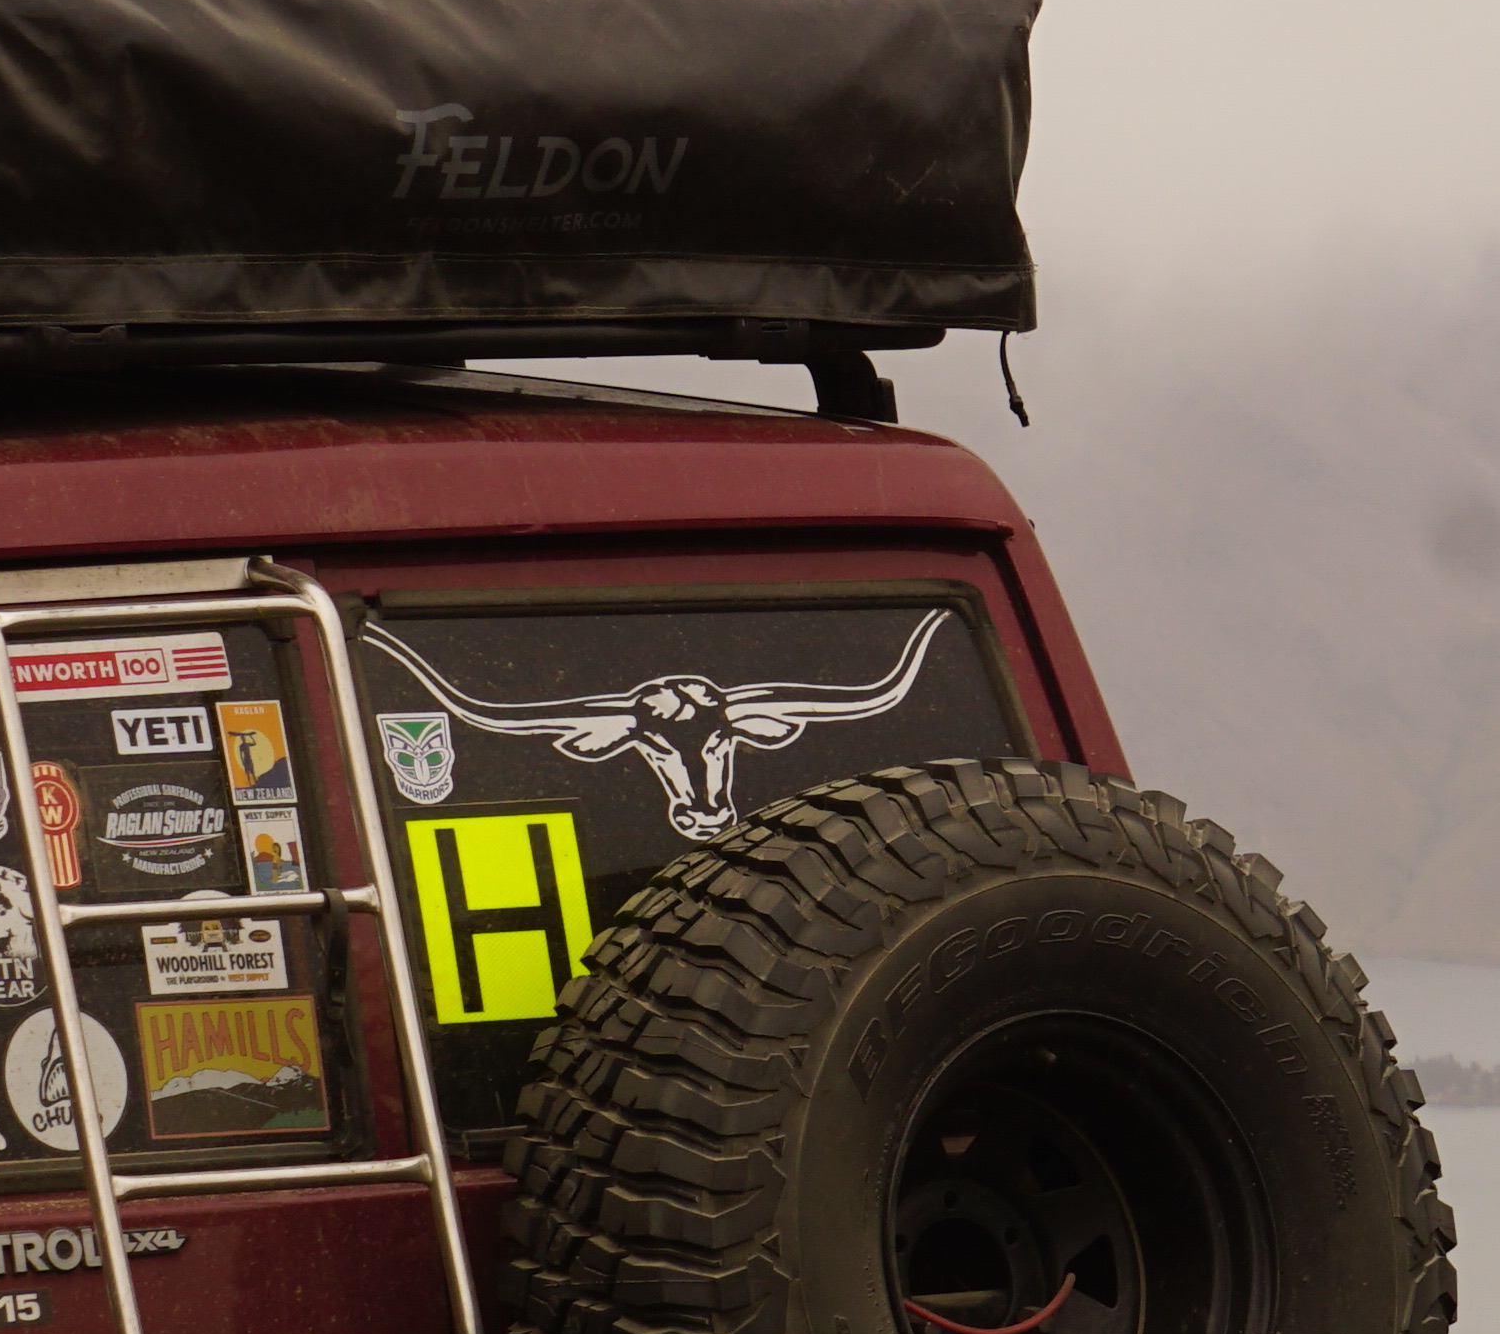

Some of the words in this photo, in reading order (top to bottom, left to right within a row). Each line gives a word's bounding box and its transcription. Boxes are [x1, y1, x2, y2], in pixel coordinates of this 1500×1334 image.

[392, 103, 689, 200] FELDON
[11, 659, 115, 684] NWORTH
[121, 656, 161, 677] 100
[116, 715, 205, 747] YETI
[235, 787, 255, 801] NEW
[256, 787, 294, 800] ZEALAND
[399, 779, 450, 800] WARRIORS
[105, 811, 164, 839] RAGLAN
[162, 809, 203, 836] SURF
[201, 807, 225, 834] CO
[132, 853, 206, 876] MANUFACTURING
[434, 822, 573, 1013] H
[155, 953, 227, 974] WOODHILL
[228, 952, 275, 971] FOREST
[150, 1007, 312, 1081] HAMILLS
[32, 1105, 77, 1133] CHU
